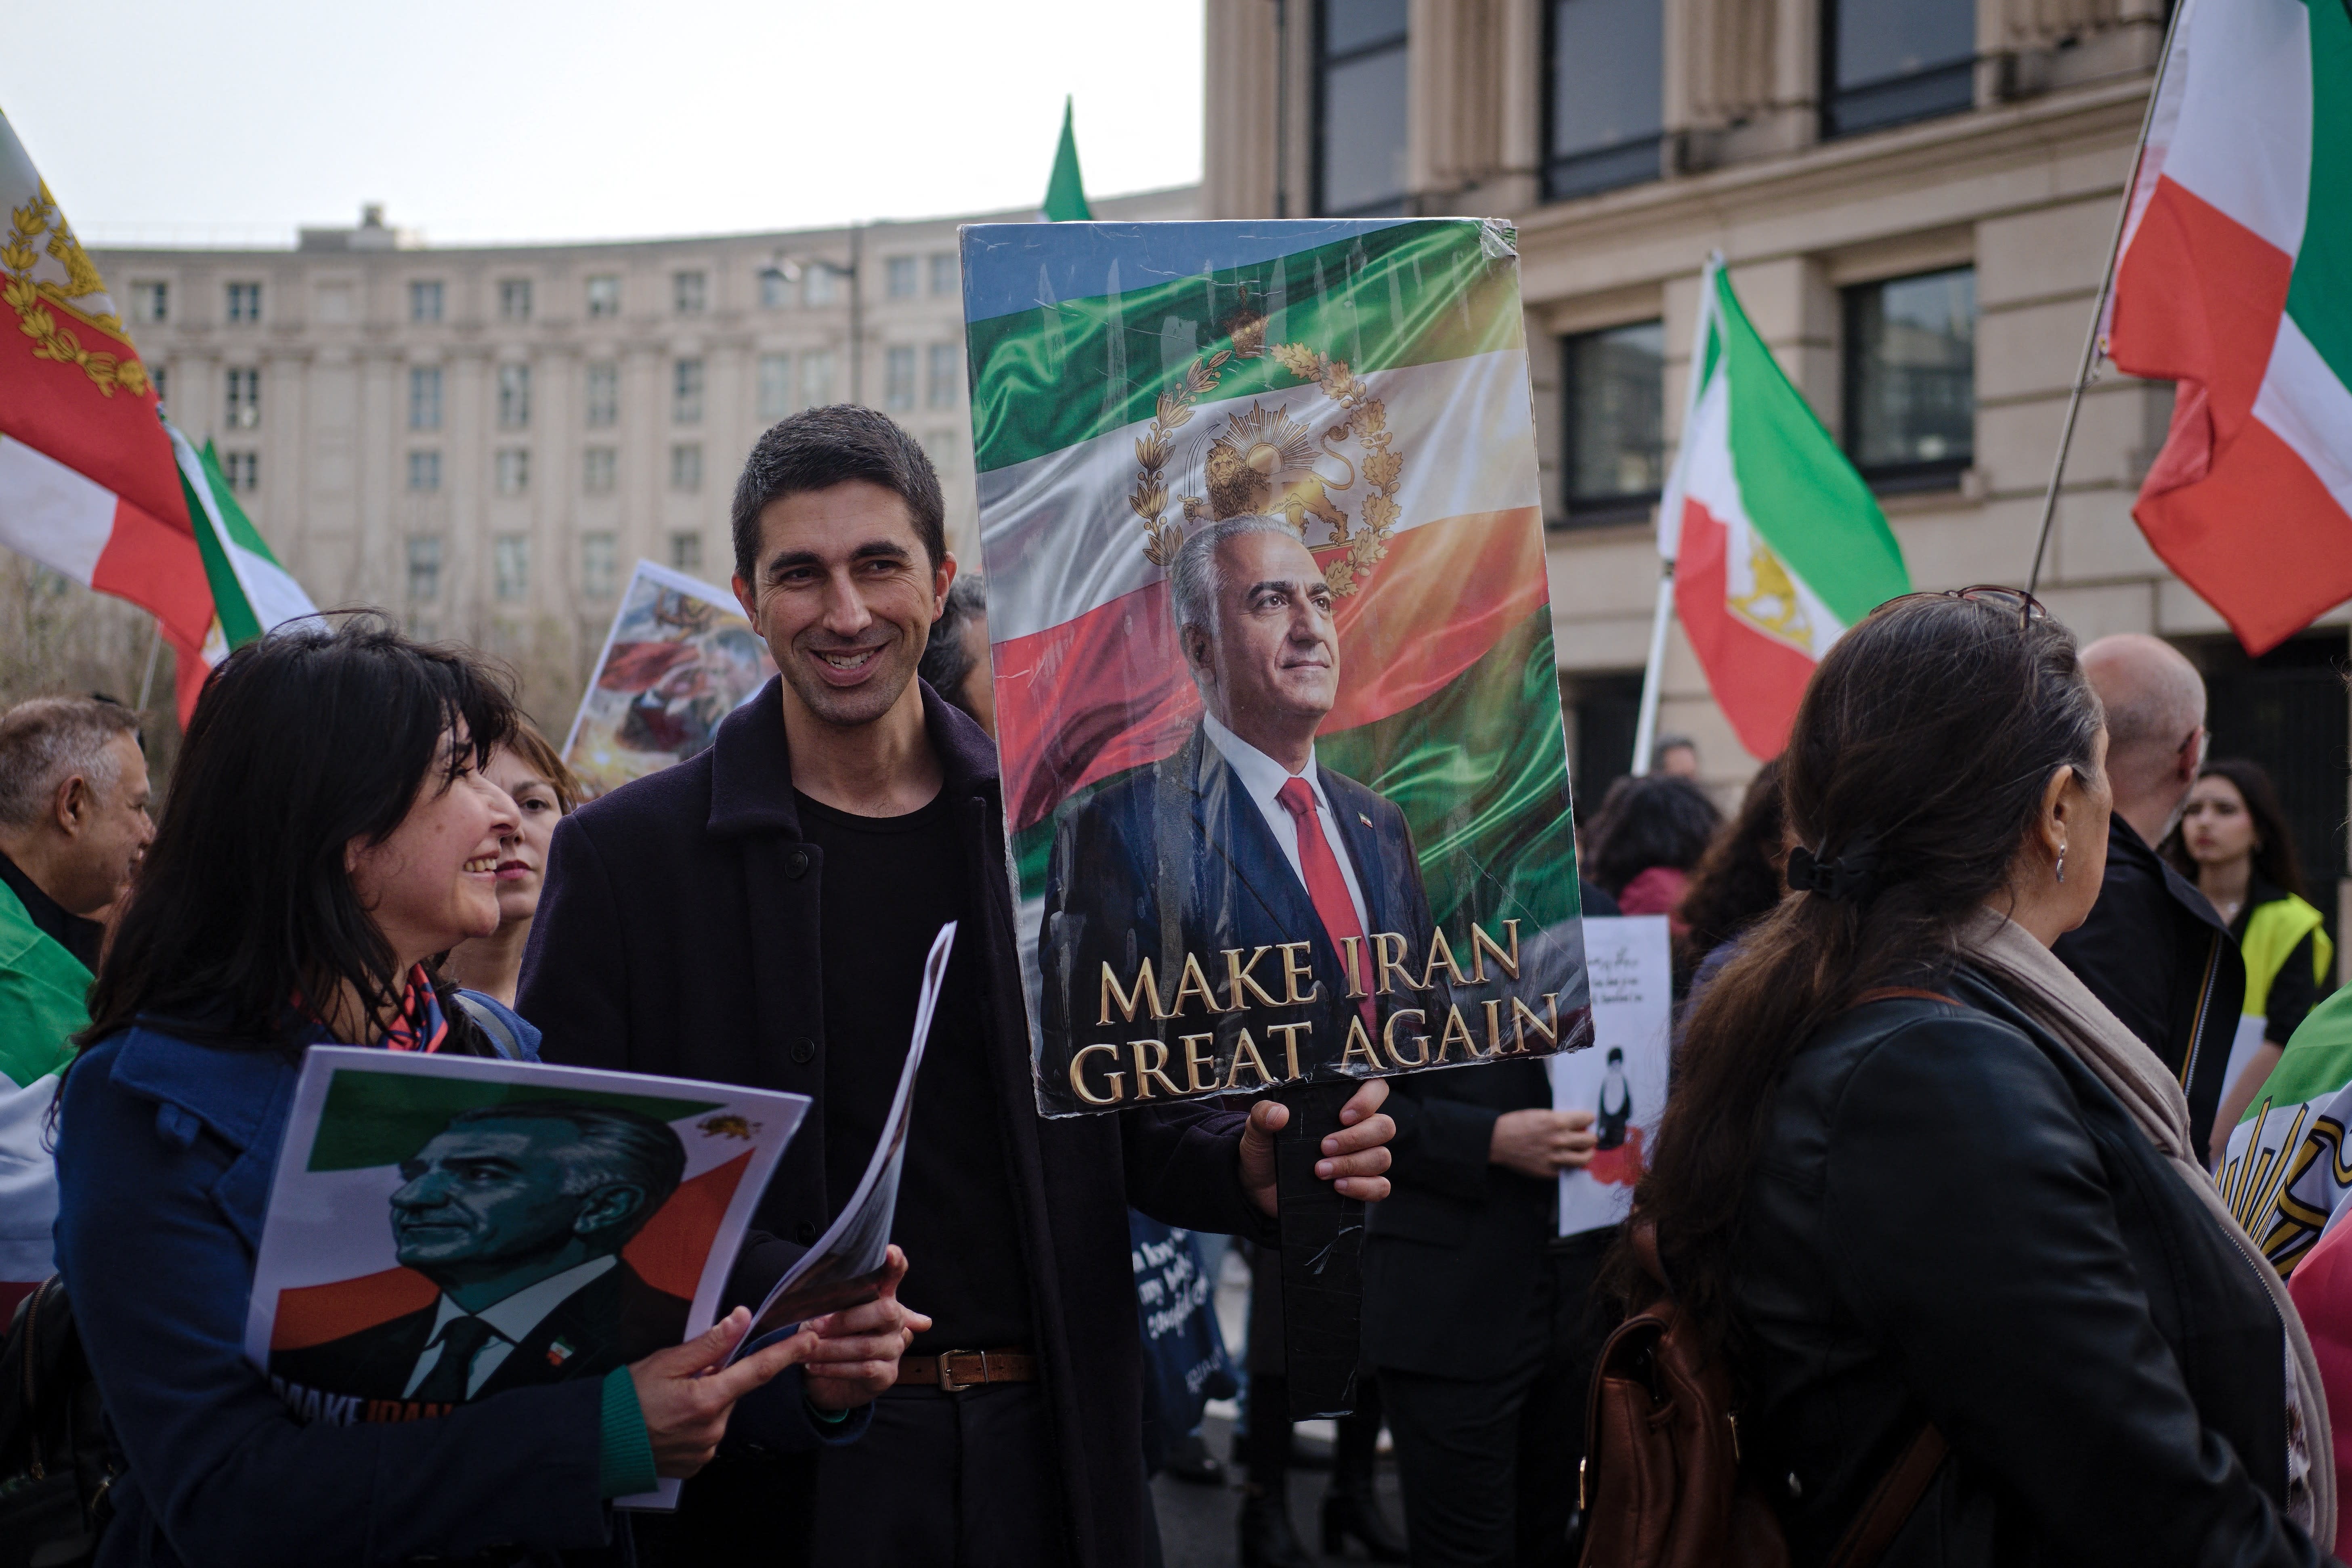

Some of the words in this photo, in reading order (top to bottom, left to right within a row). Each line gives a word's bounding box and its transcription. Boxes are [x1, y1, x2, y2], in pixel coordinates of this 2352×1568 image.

[1096, 941, 1317, 1026] MAKE
[1340, 919, 1521, 999] IRAN
[1070, 1021, 1312, 1105] GREAT
[1340, 993, 1559, 1073] AGAIN
